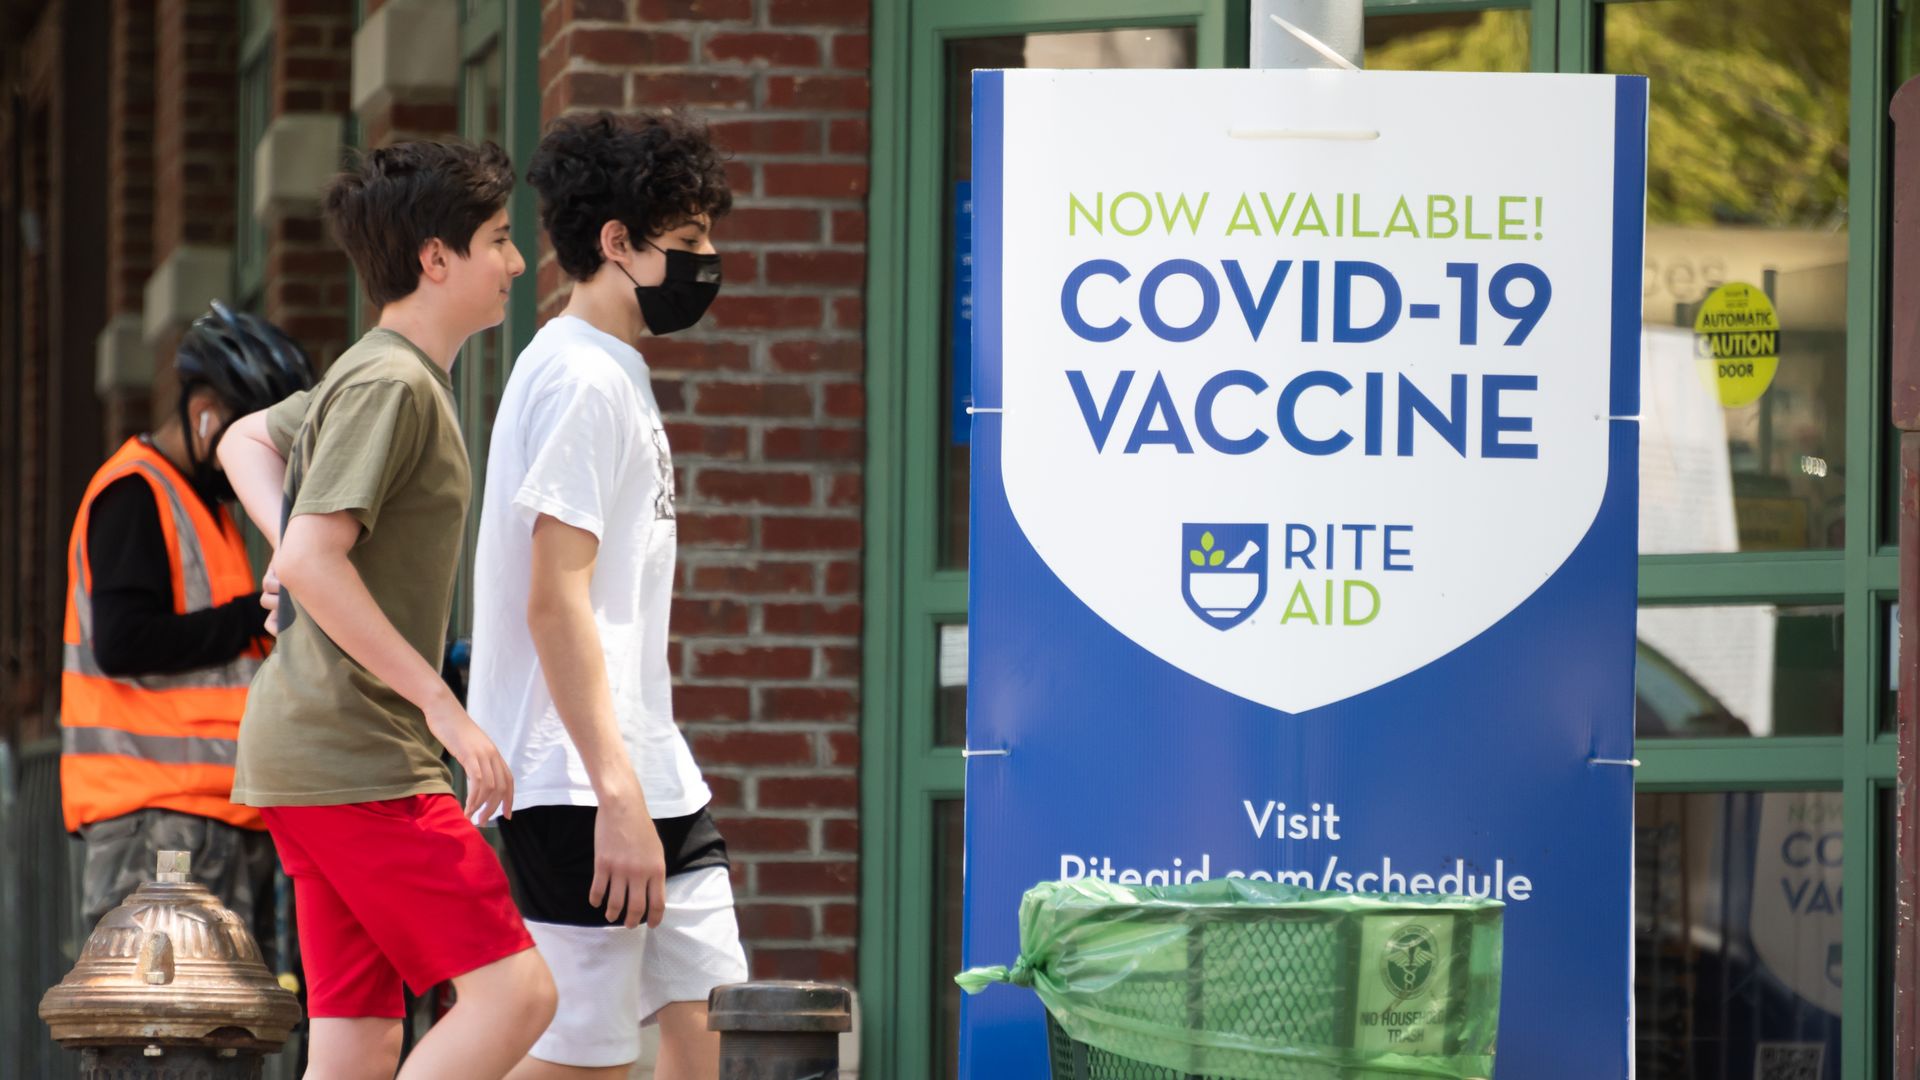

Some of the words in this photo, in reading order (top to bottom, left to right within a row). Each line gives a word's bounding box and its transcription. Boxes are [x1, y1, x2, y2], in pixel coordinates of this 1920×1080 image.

[1070, 192, 1208, 236] NOW
[1227, 192, 1544, 240] AVAILABLE!
[1061, 259, 1552, 346] COVID-19
[1703, 311, 1772, 327] AUTOMATIC
[1698, 334, 1775, 357] CAUTION
[1718, 364, 1754, 378] DOOR
[1066, 370, 1538, 459] VACCINE
[1285, 524, 1414, 571] RITE
[1280, 580, 1381, 626] AID
[1243, 800, 1341, 840] Visit
[1060, 854, 1532, 901] Riteaidm/schedule
[1781, 877, 1843, 914] VA
[1360, 1011, 1378, 1026] NO
